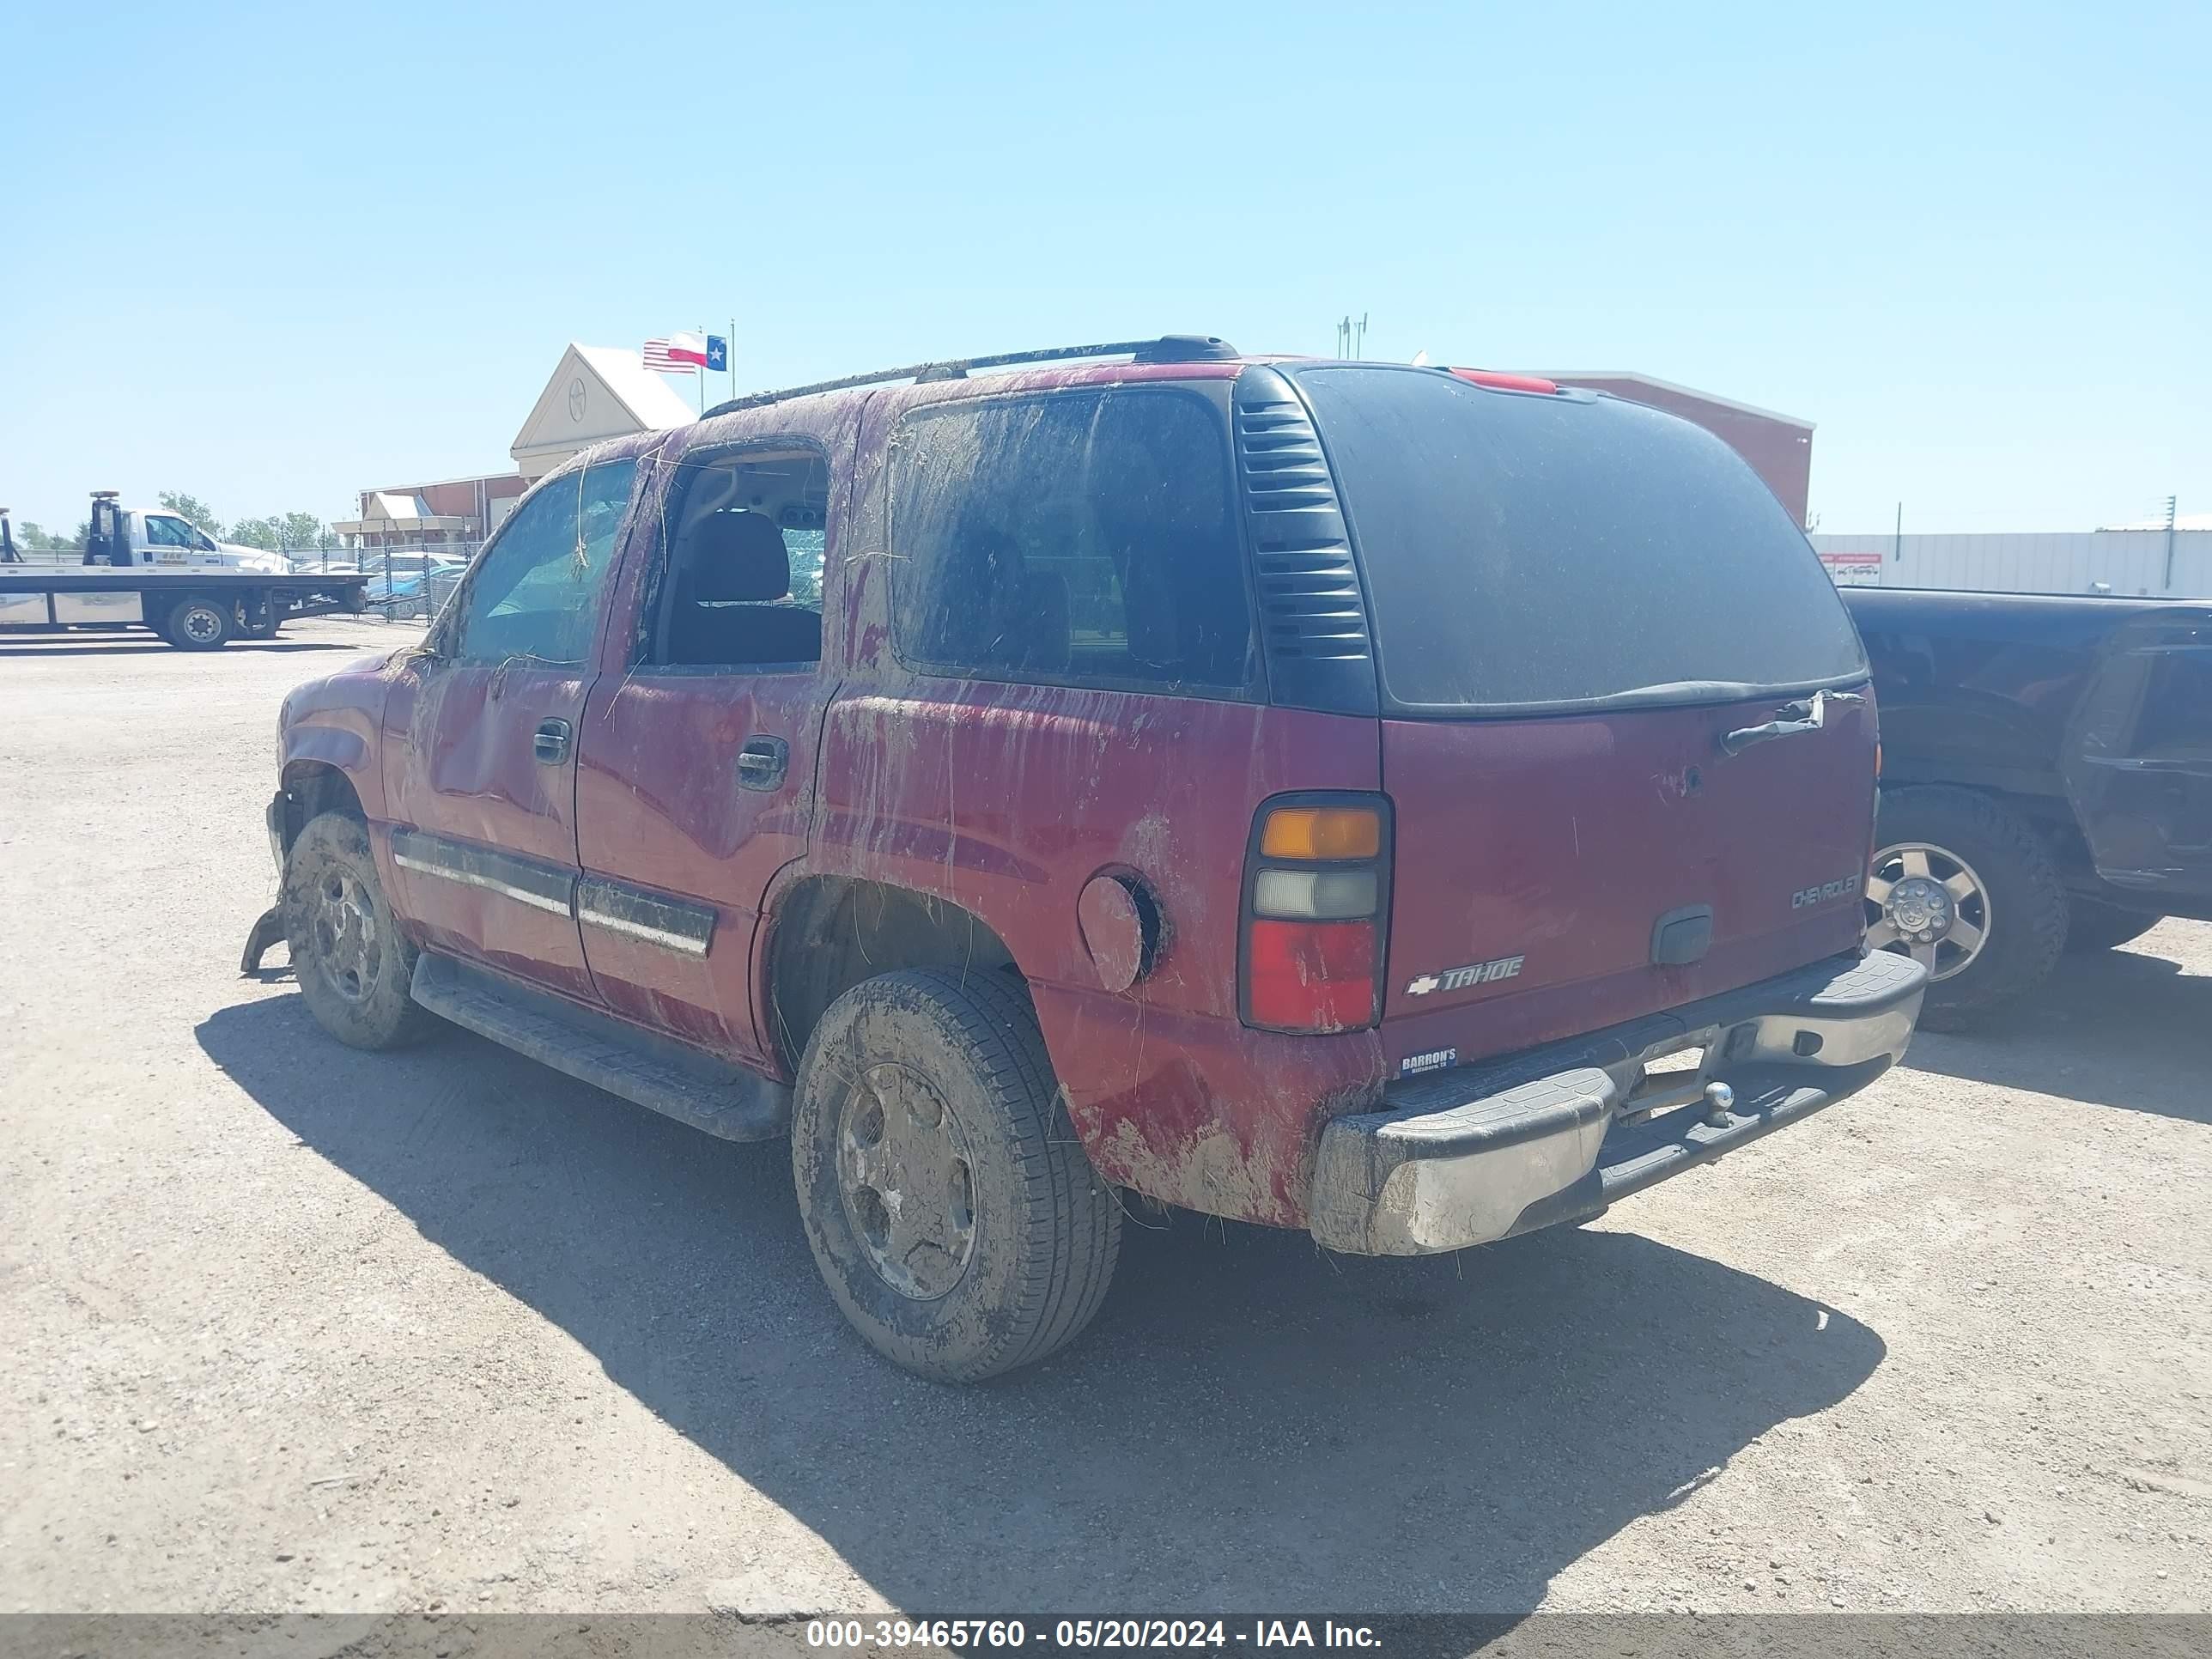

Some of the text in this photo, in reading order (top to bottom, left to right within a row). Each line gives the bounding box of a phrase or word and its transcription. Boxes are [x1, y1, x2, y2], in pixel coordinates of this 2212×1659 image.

[1792, 874, 1862, 908] CHEVROLET
[1443, 957, 1525, 990] TAHOE
[1402, 1048, 1455, 1071] BARRON'S
